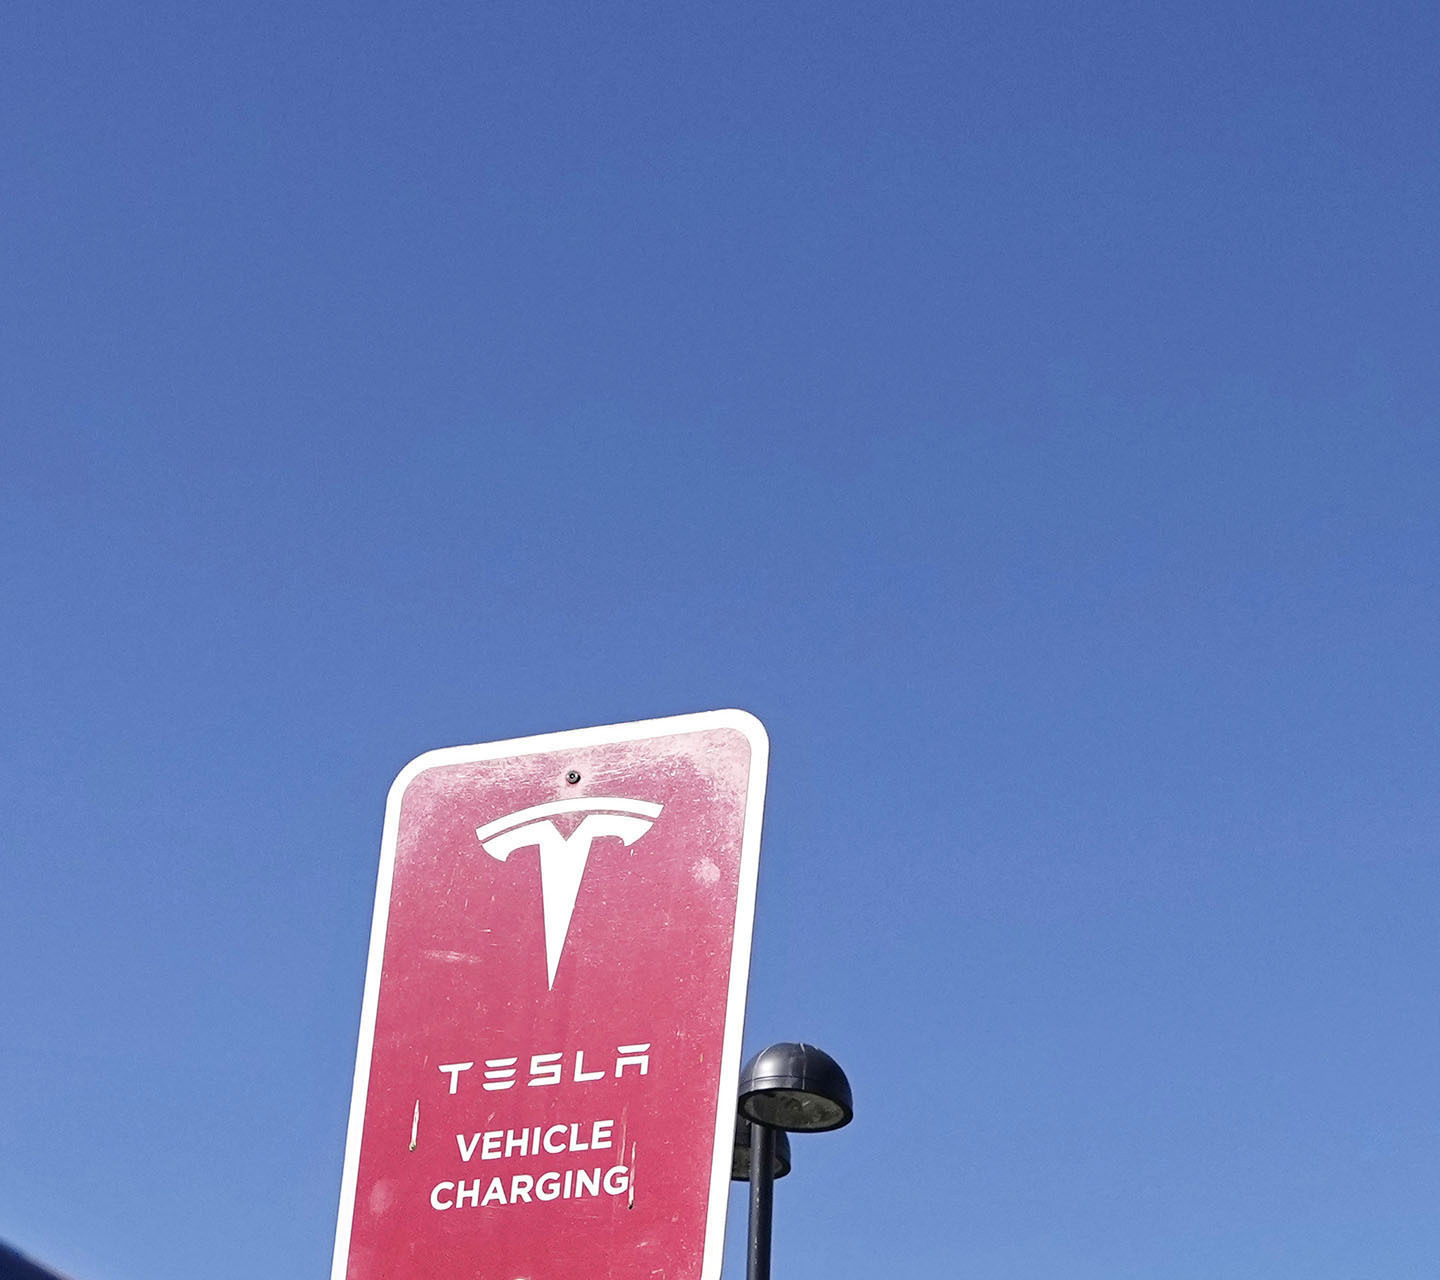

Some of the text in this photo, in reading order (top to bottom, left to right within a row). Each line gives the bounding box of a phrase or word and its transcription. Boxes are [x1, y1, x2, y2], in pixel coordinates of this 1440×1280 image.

[438, 1043, 651, 1095] TESLA
[456, 1119, 614, 1162] VEHICLE
[430, 1165, 630, 1211] CHARGING
